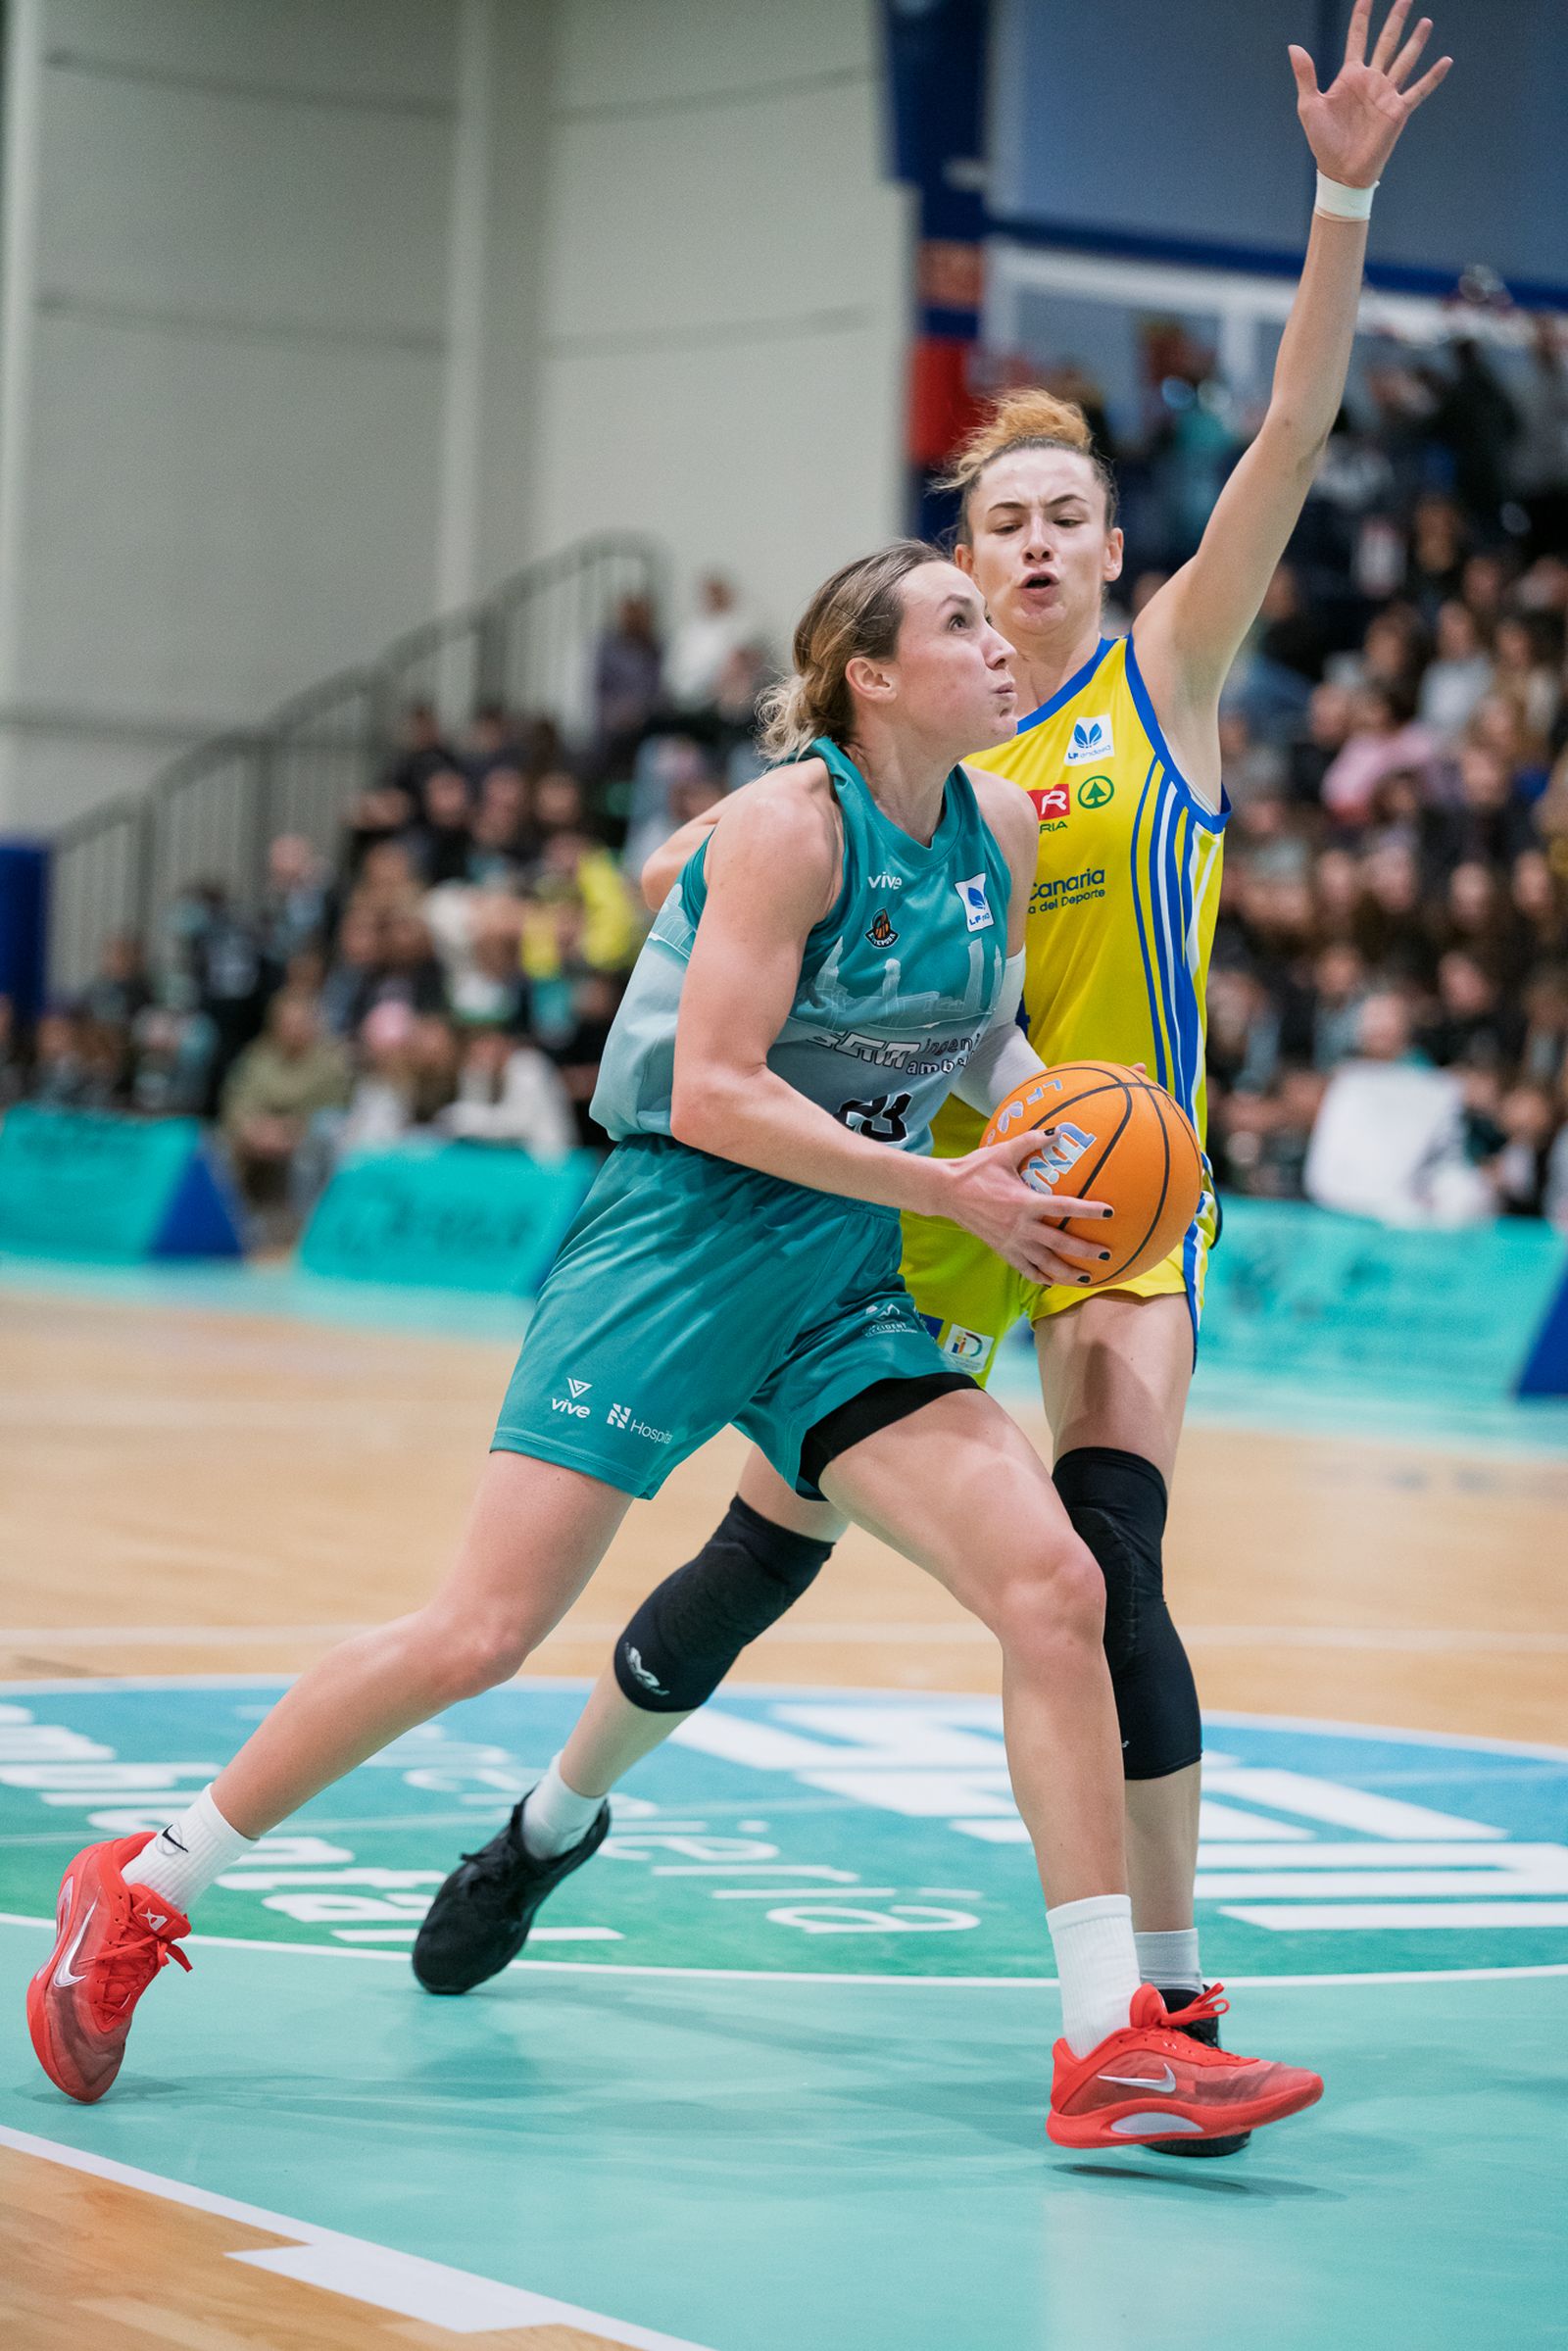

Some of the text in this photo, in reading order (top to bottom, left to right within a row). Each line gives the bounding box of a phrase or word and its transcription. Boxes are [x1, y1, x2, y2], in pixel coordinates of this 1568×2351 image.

[867, 872, 903, 890] vive
[1039, 898, 1058, 912] del
[1061, 889, 1105, 906] Deporte
[552, 1397, 591, 1419] vive
